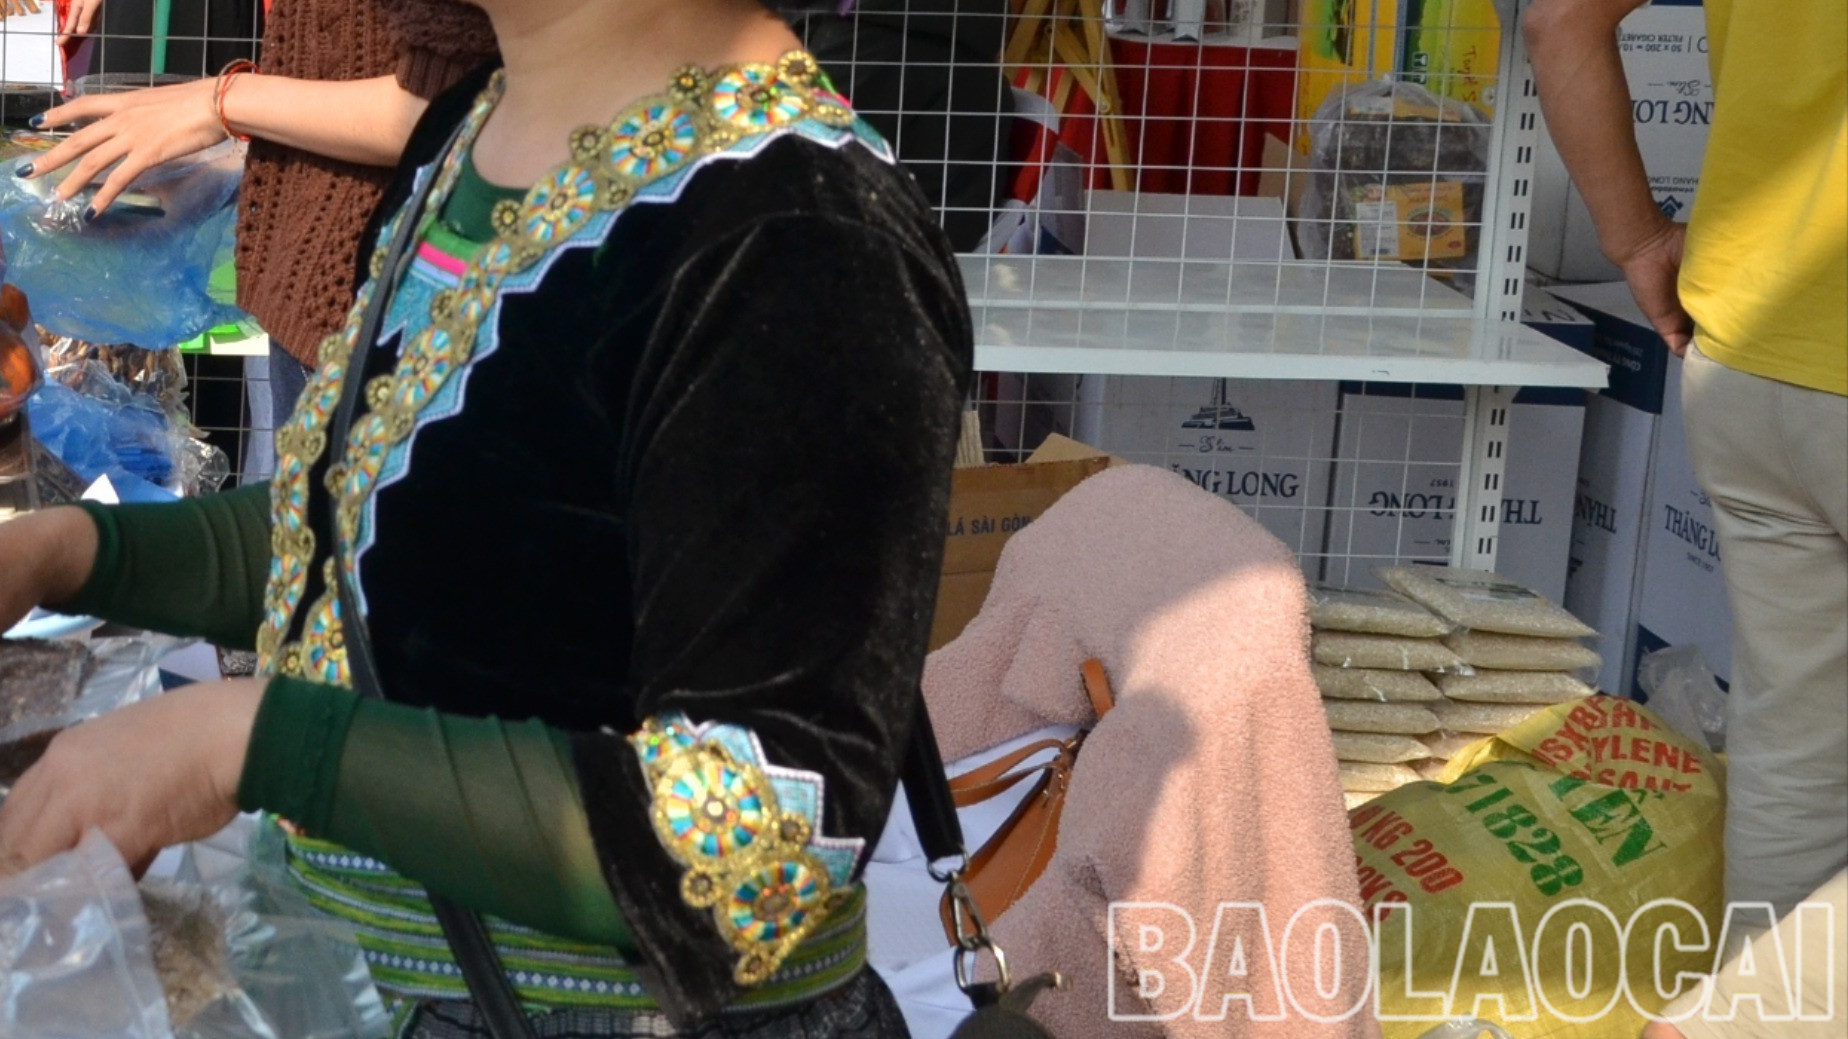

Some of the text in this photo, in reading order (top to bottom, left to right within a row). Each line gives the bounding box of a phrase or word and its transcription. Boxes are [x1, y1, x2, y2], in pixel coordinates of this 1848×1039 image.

[1633, 100, 1669, 124] LO
[1226, 472, 1301, 500] LONG
[1368, 491, 1443, 519] LONG
[972, 515, 995, 534] SÀI
[1590, 734, 1703, 775] YLENE
[1390, 838, 1464, 895] 200
